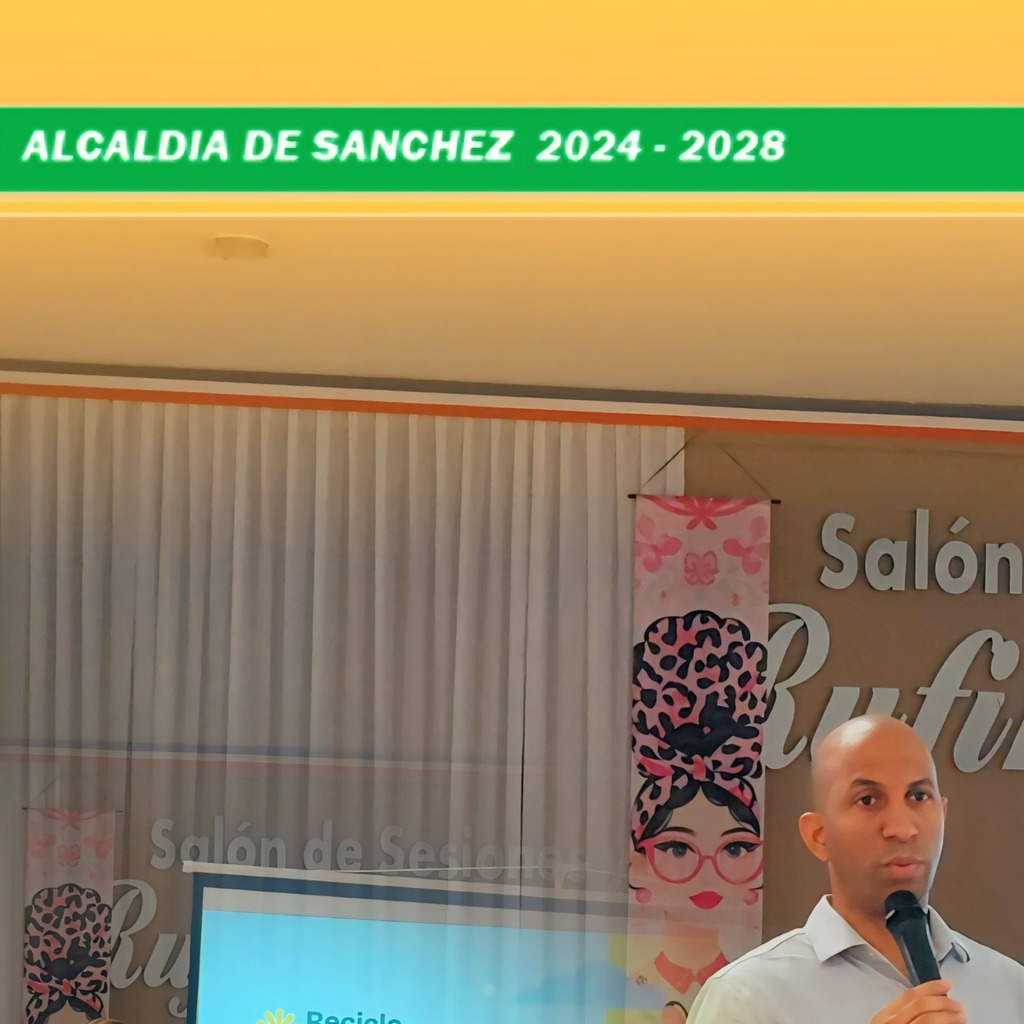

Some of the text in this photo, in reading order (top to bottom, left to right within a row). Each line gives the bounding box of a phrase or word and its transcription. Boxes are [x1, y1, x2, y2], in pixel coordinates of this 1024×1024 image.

[819, 508, 1024, 595] Salón
[150, 815, 287, 870] Salón
[303, 819, 364, 872] de
